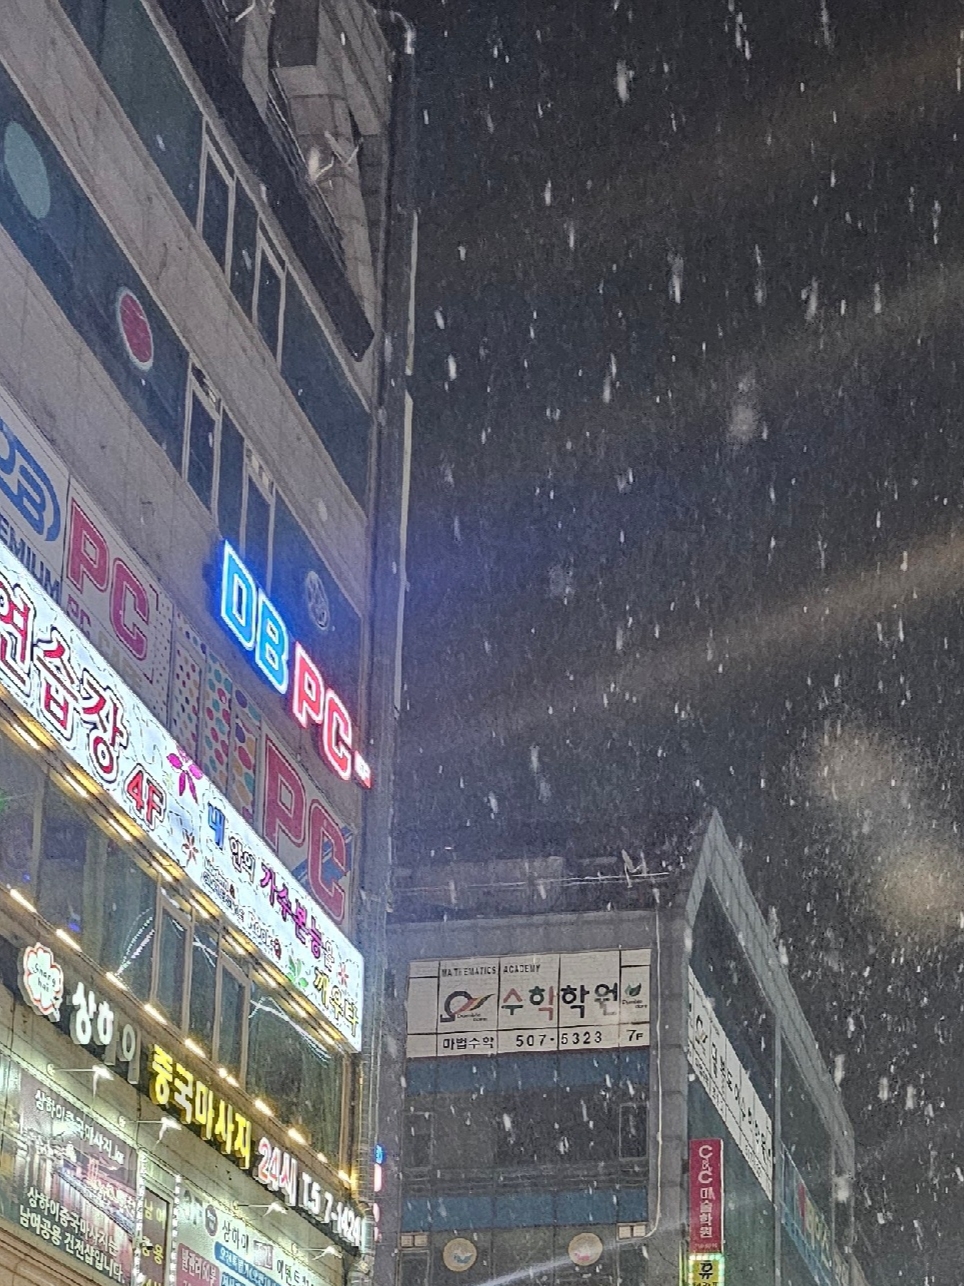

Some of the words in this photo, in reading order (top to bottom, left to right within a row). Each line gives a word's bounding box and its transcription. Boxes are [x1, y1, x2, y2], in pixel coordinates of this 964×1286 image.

[66, 497, 149, 661] PC
[221, 539, 290, 694] DB
[292, 640, 352, 780] PC
[127, 770, 163, 825] 4F
[264, 733, 348, 926] PC
[441, 966, 497, 978] MATHEMATICS
[503, 963, 541, 975] ACADEMY
[501, 981, 618, 1022] 수학학원
[627, 1029, 644, 1042] 7F
[150, 1044, 252, 1171] 중국마사지
[258, 1136, 298, 1207] 24시
[699, 1260, 714, 1279] 휴
